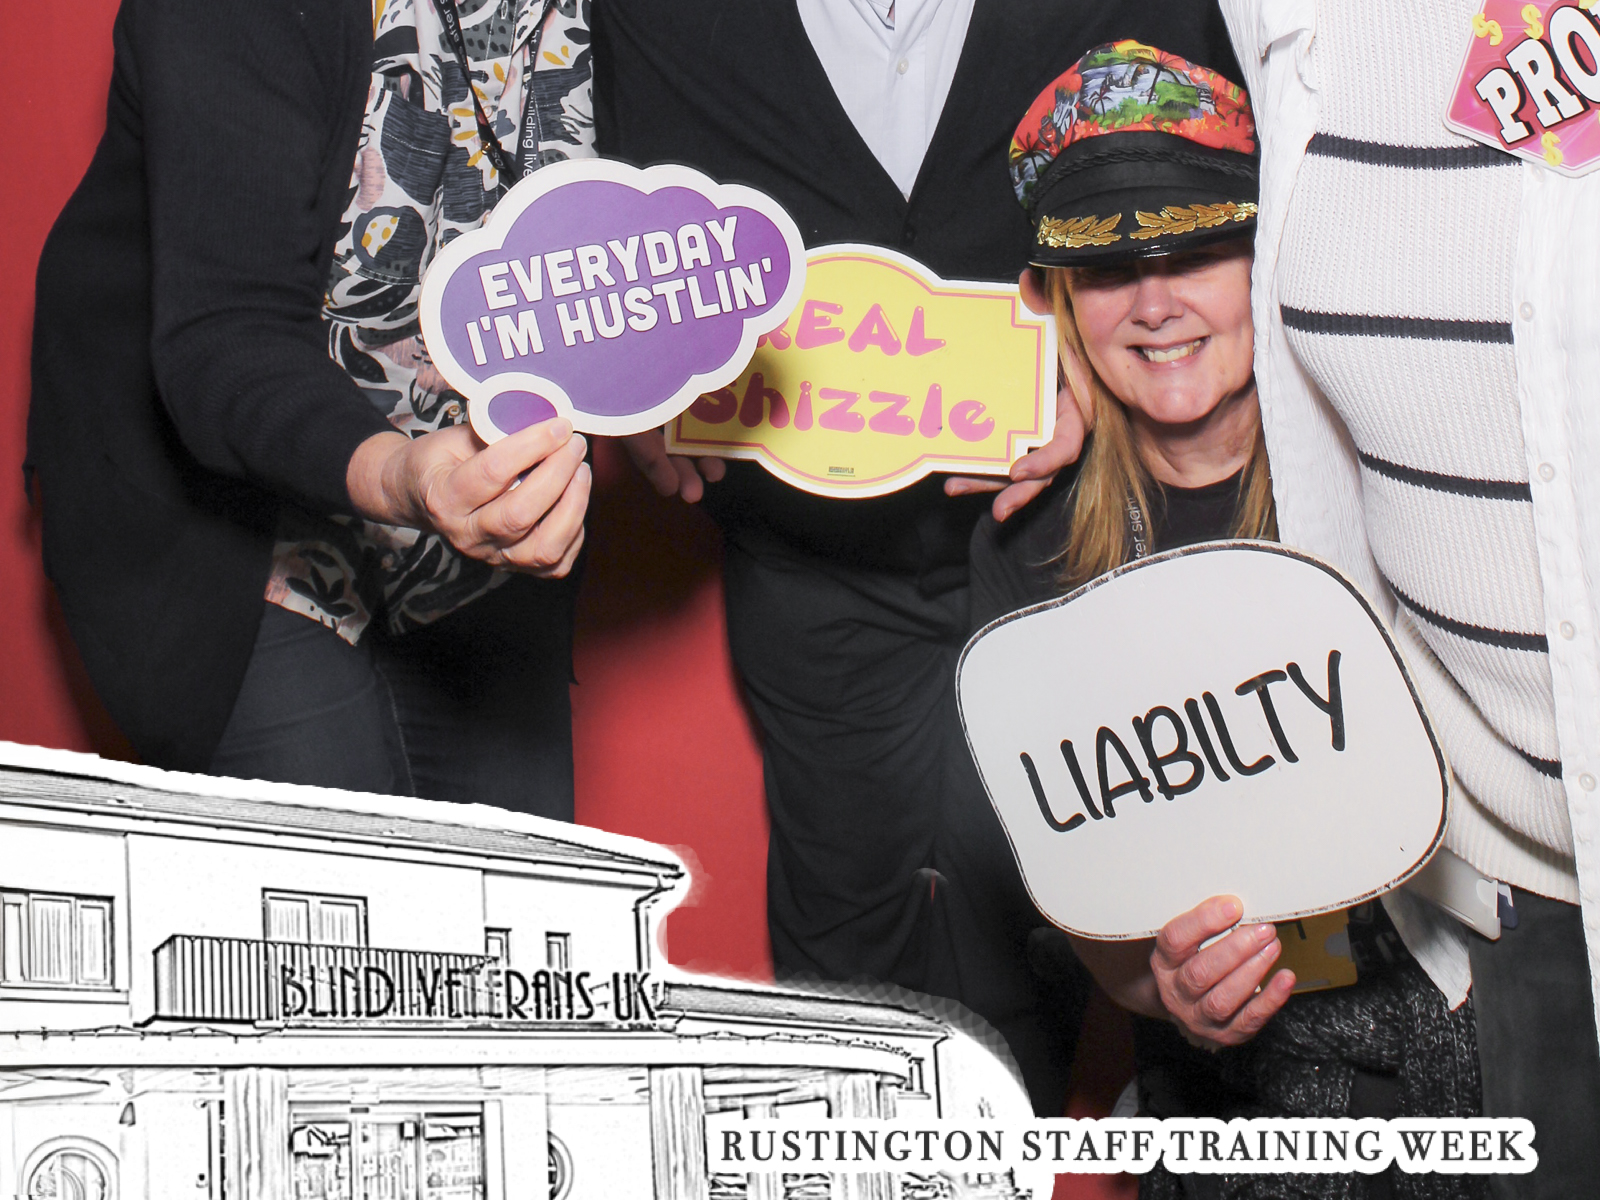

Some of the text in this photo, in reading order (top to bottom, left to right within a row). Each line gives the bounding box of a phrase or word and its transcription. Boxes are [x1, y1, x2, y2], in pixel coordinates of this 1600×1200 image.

[466, 257, 772, 366] I'M HUSTLIN'
[478, 215, 738, 311] EVERYDAY
[1019, 649, 1345, 834] LIABILTY
